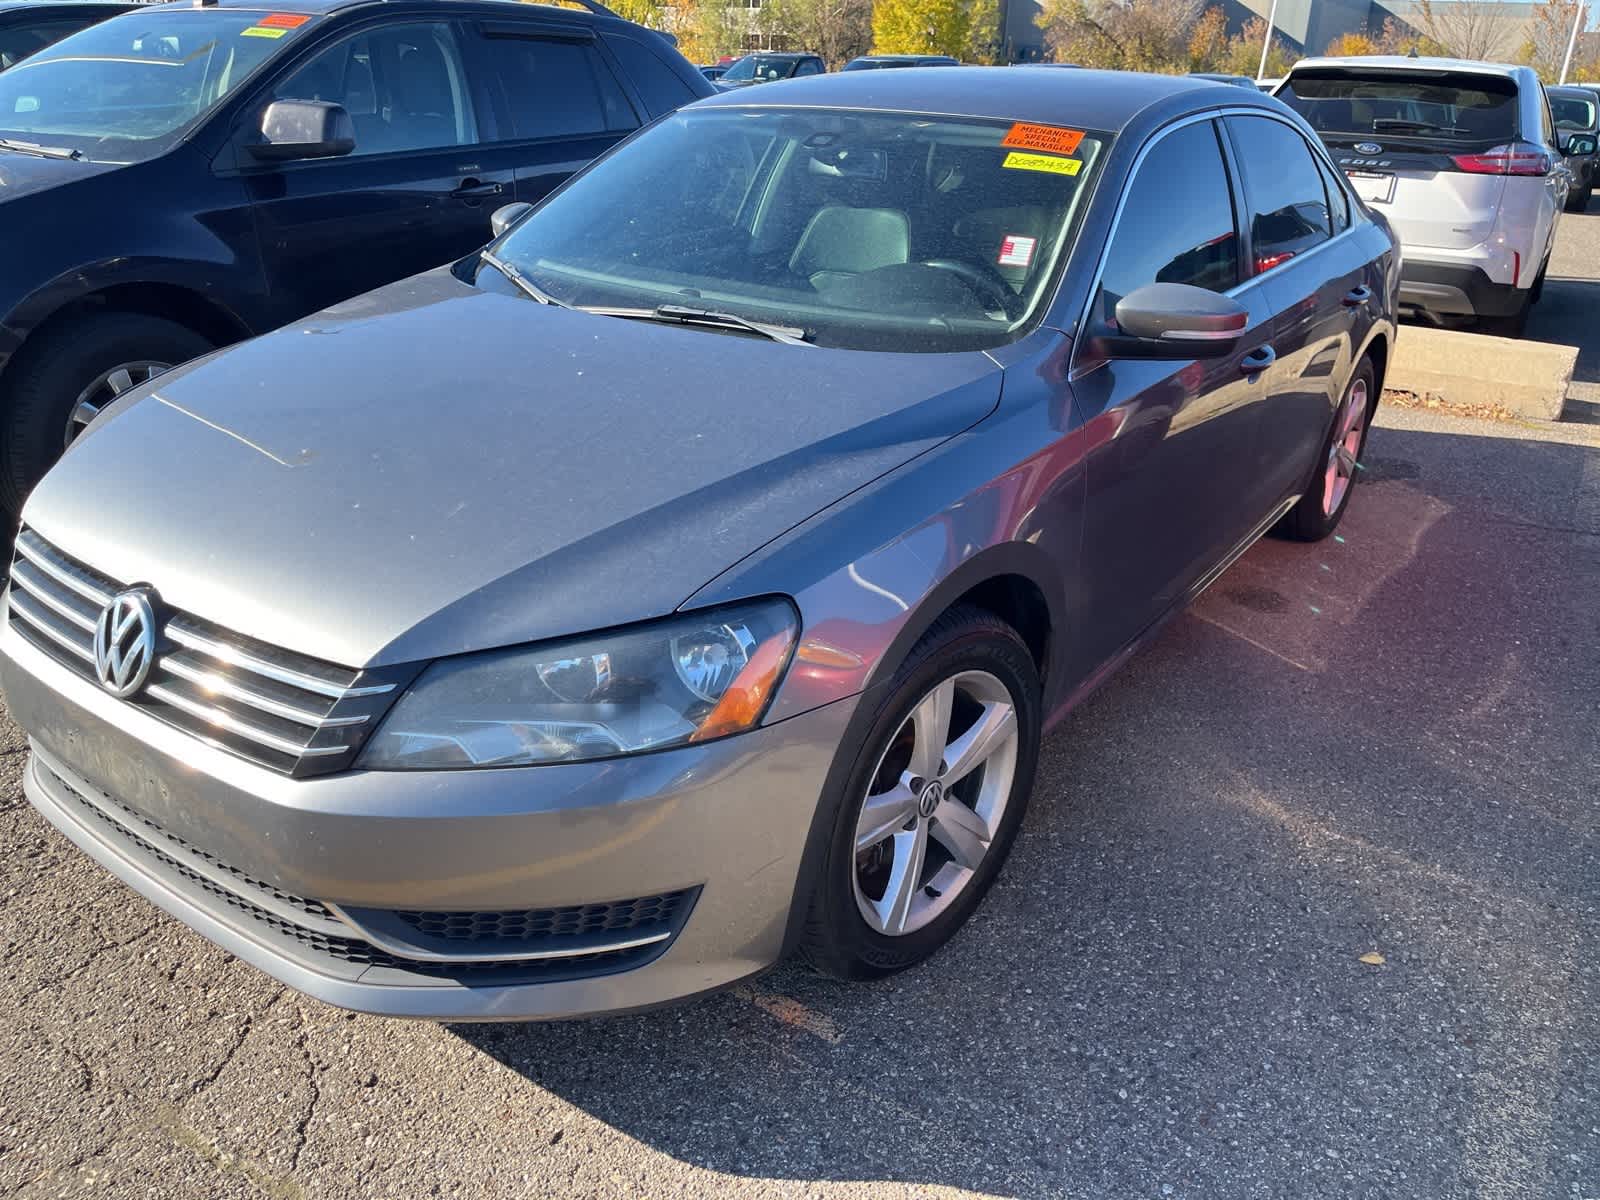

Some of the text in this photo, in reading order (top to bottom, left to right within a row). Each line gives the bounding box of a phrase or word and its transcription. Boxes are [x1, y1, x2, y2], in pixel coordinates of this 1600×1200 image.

[1021, 126, 1073, 138] MECHANICS
[1024, 133, 1061, 143] SPECIAL
[1026, 140, 1072, 152] MANAGER
[1340, 159, 1391, 167] EDGE
